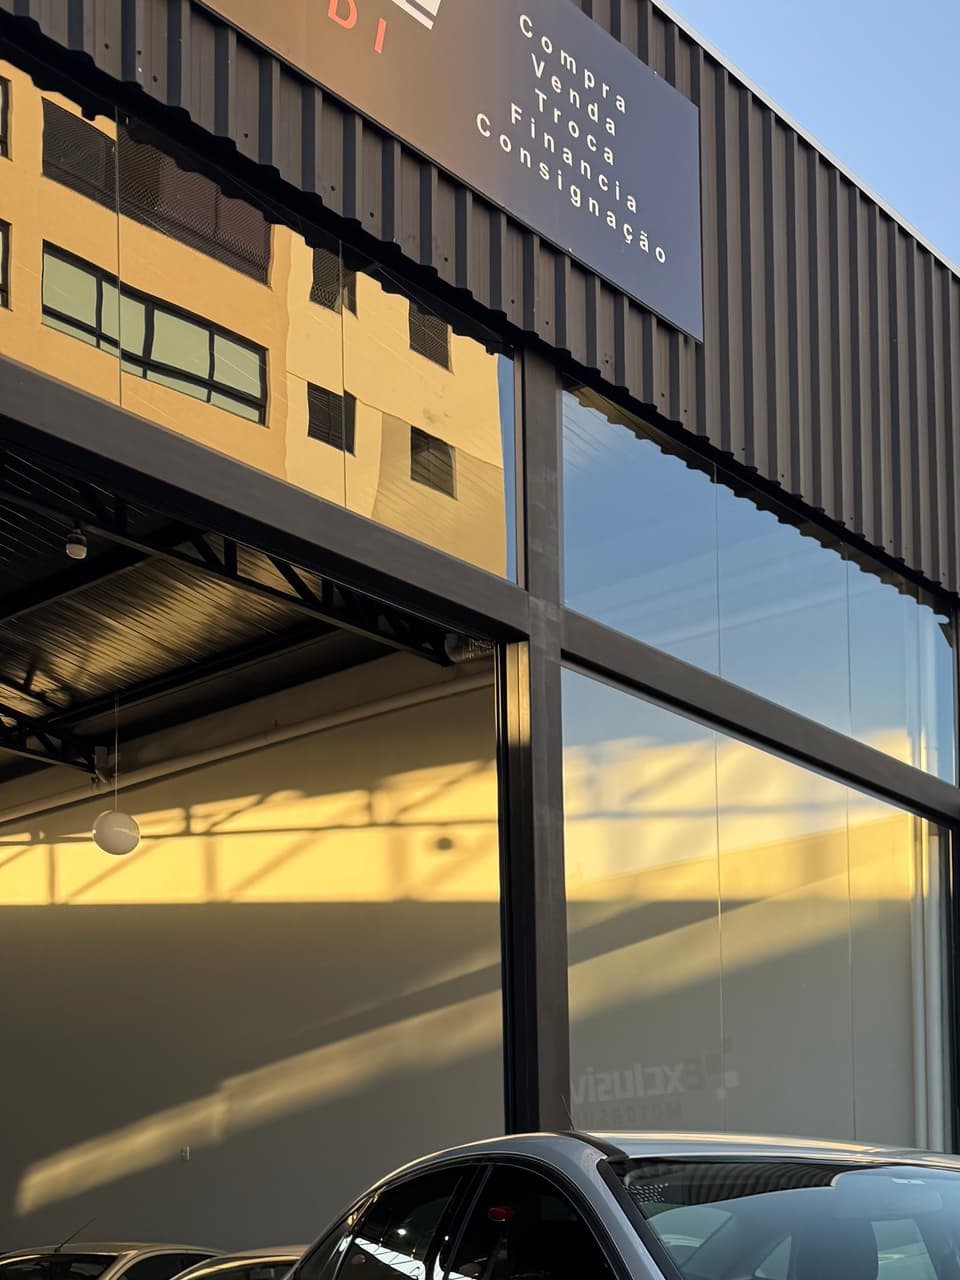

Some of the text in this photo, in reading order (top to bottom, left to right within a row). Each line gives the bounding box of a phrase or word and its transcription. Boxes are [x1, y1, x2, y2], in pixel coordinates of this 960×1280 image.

[519, 14, 626, 113] Compra
[531, 54, 615, 136] Venda
[510, 103, 637, 213] Financia
[535, 89, 614, 165] Troca
[476, 113, 666, 264] Consignação
